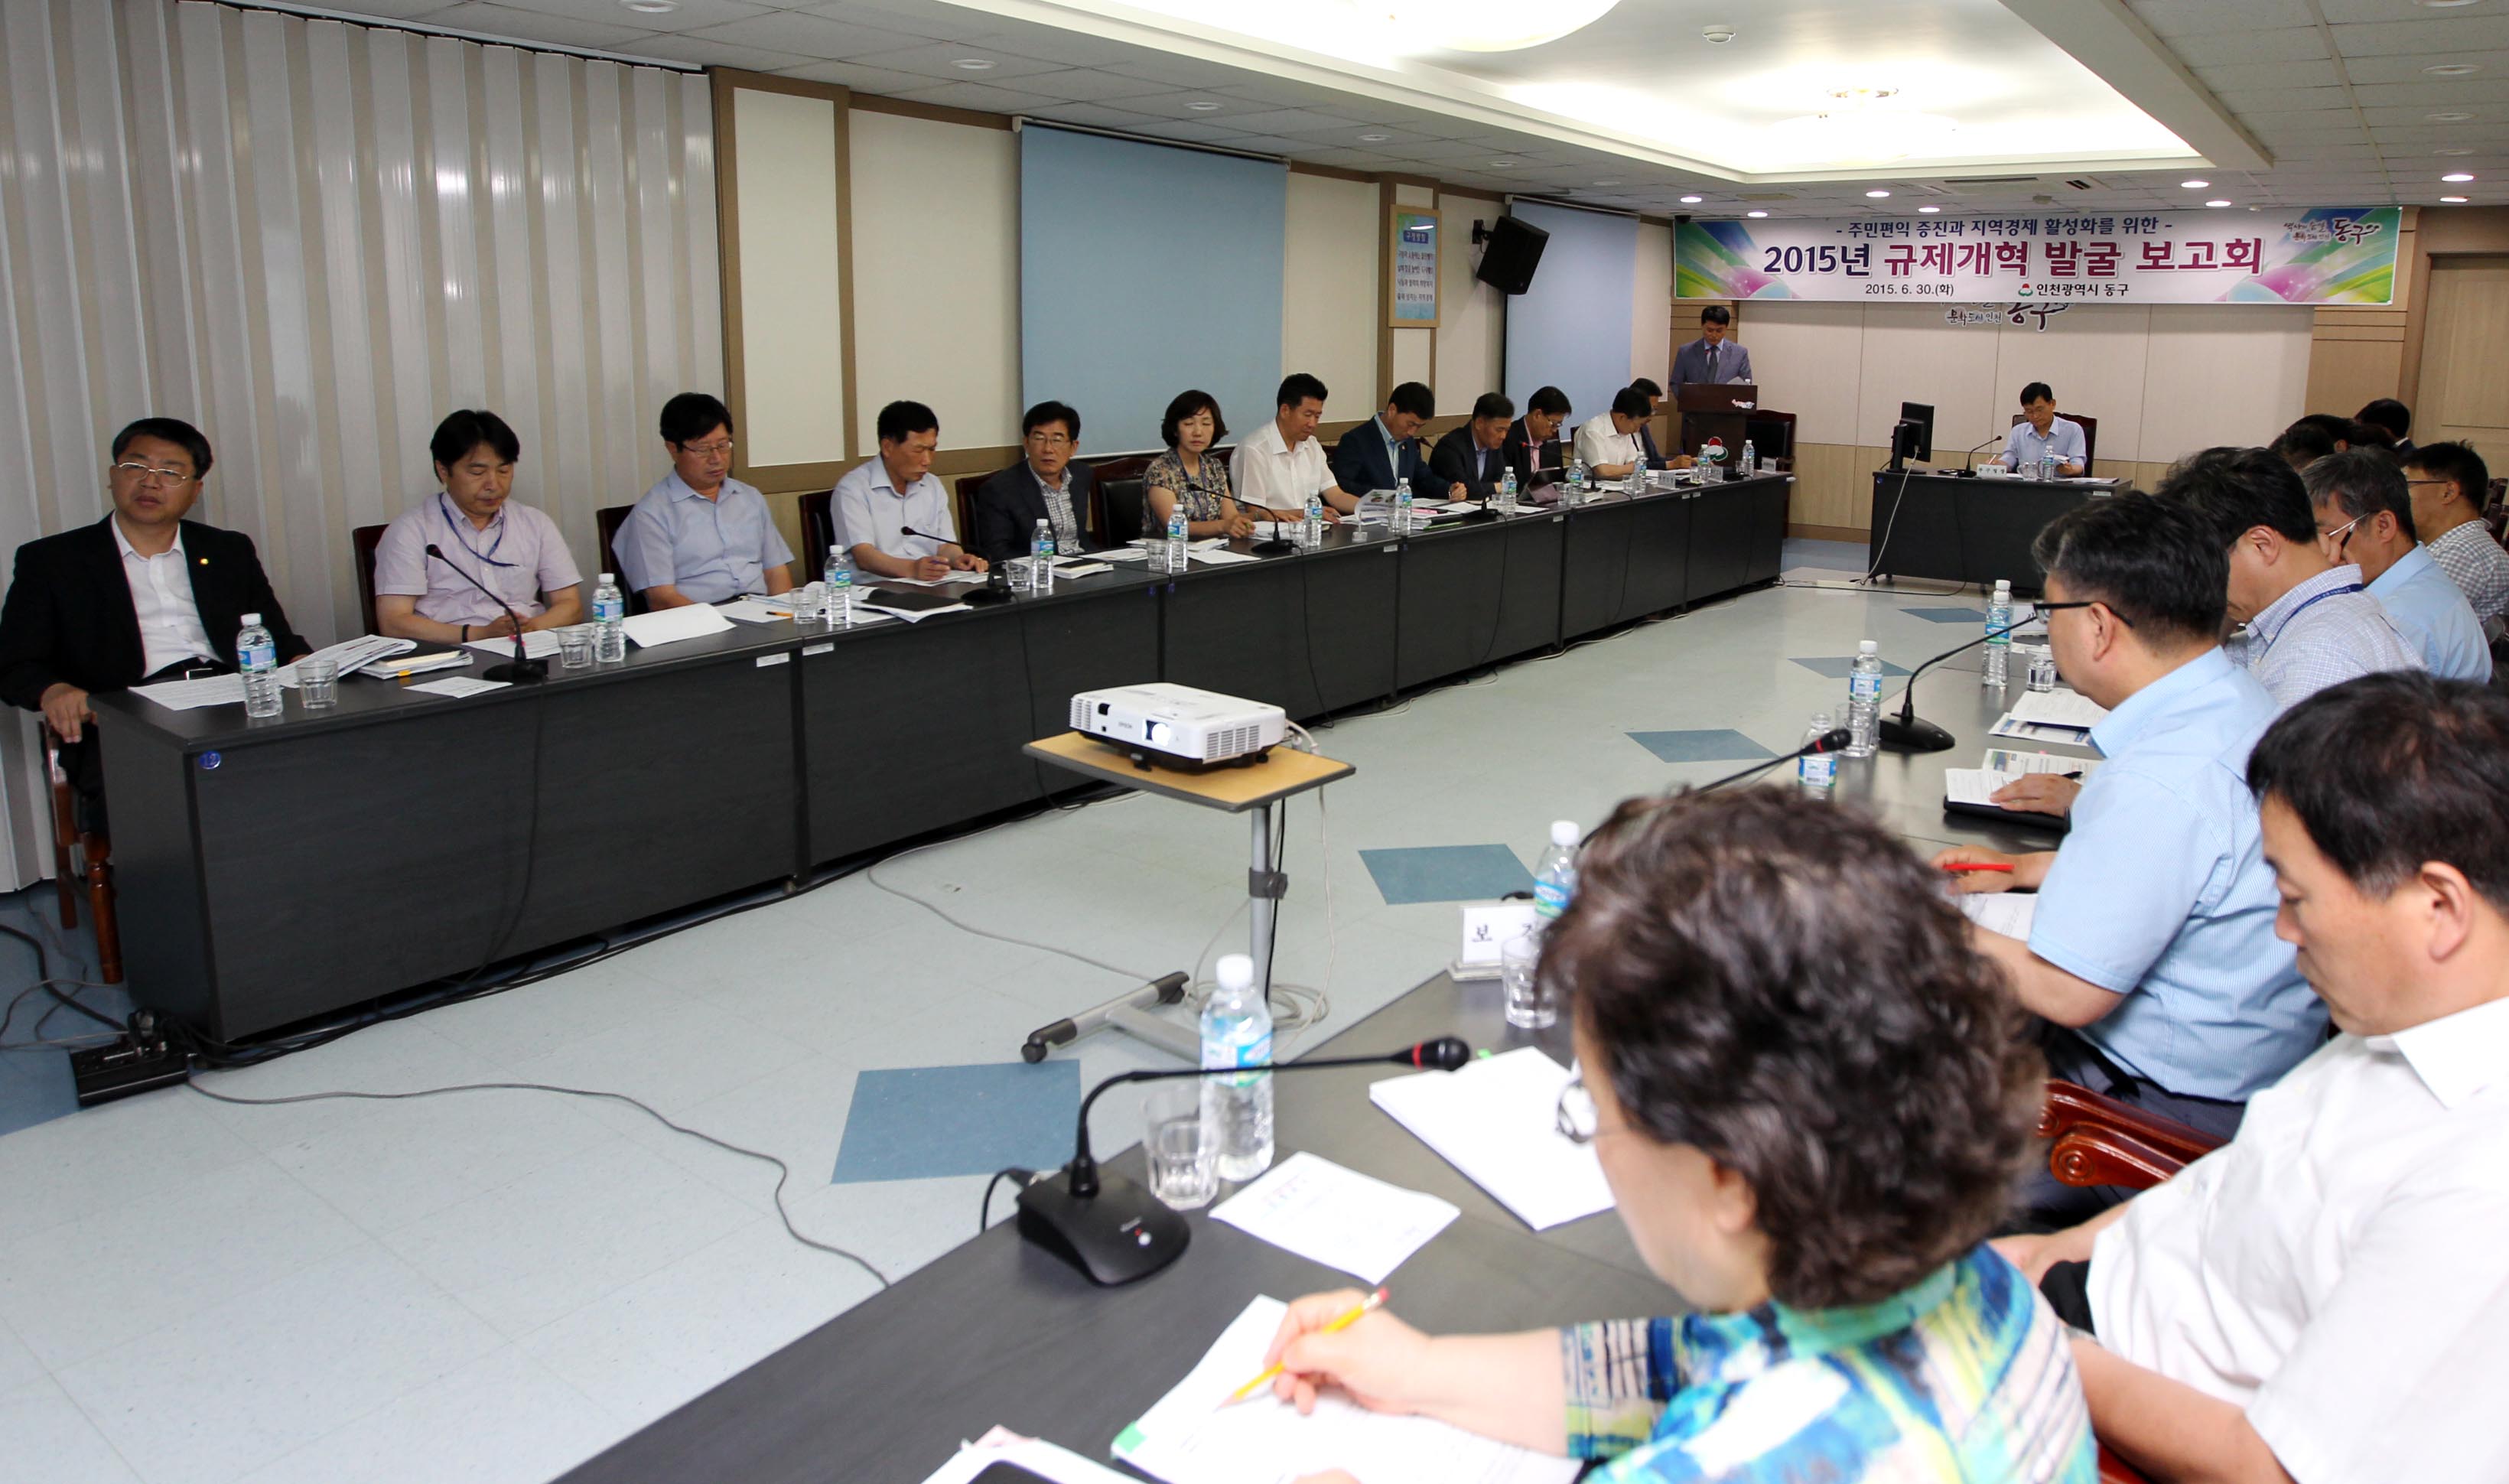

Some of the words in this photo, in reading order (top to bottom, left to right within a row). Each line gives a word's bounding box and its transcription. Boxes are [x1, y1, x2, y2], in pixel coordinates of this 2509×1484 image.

[1848, 221, 1909, 238] 주민편익
[1916, 220, 1964, 237] 증진과
[1971, 219, 2038, 236] 지역경제
[2045, 218, 2115, 236] 활성화를
[2122, 216, 2159, 234] 위한
[2335, 219, 2379, 245] 동구
[1763, 243, 1870, 276] 2015년
[1884, 241, 2028, 276] 규제개혁
[2045, 241, 2123, 276] 발굴
[2136, 238, 2262, 275] 보고회
[1866, 284, 1897, 295] 2015.
[1902, 284, 1912, 295] 6.
[1916, 284, 1954, 296] 30.(화)
[2036, 284, 2098, 296] 인천광역시
[2104, 283, 2130, 296] 동구
[1947, 309, 1983, 326] 문화도시
